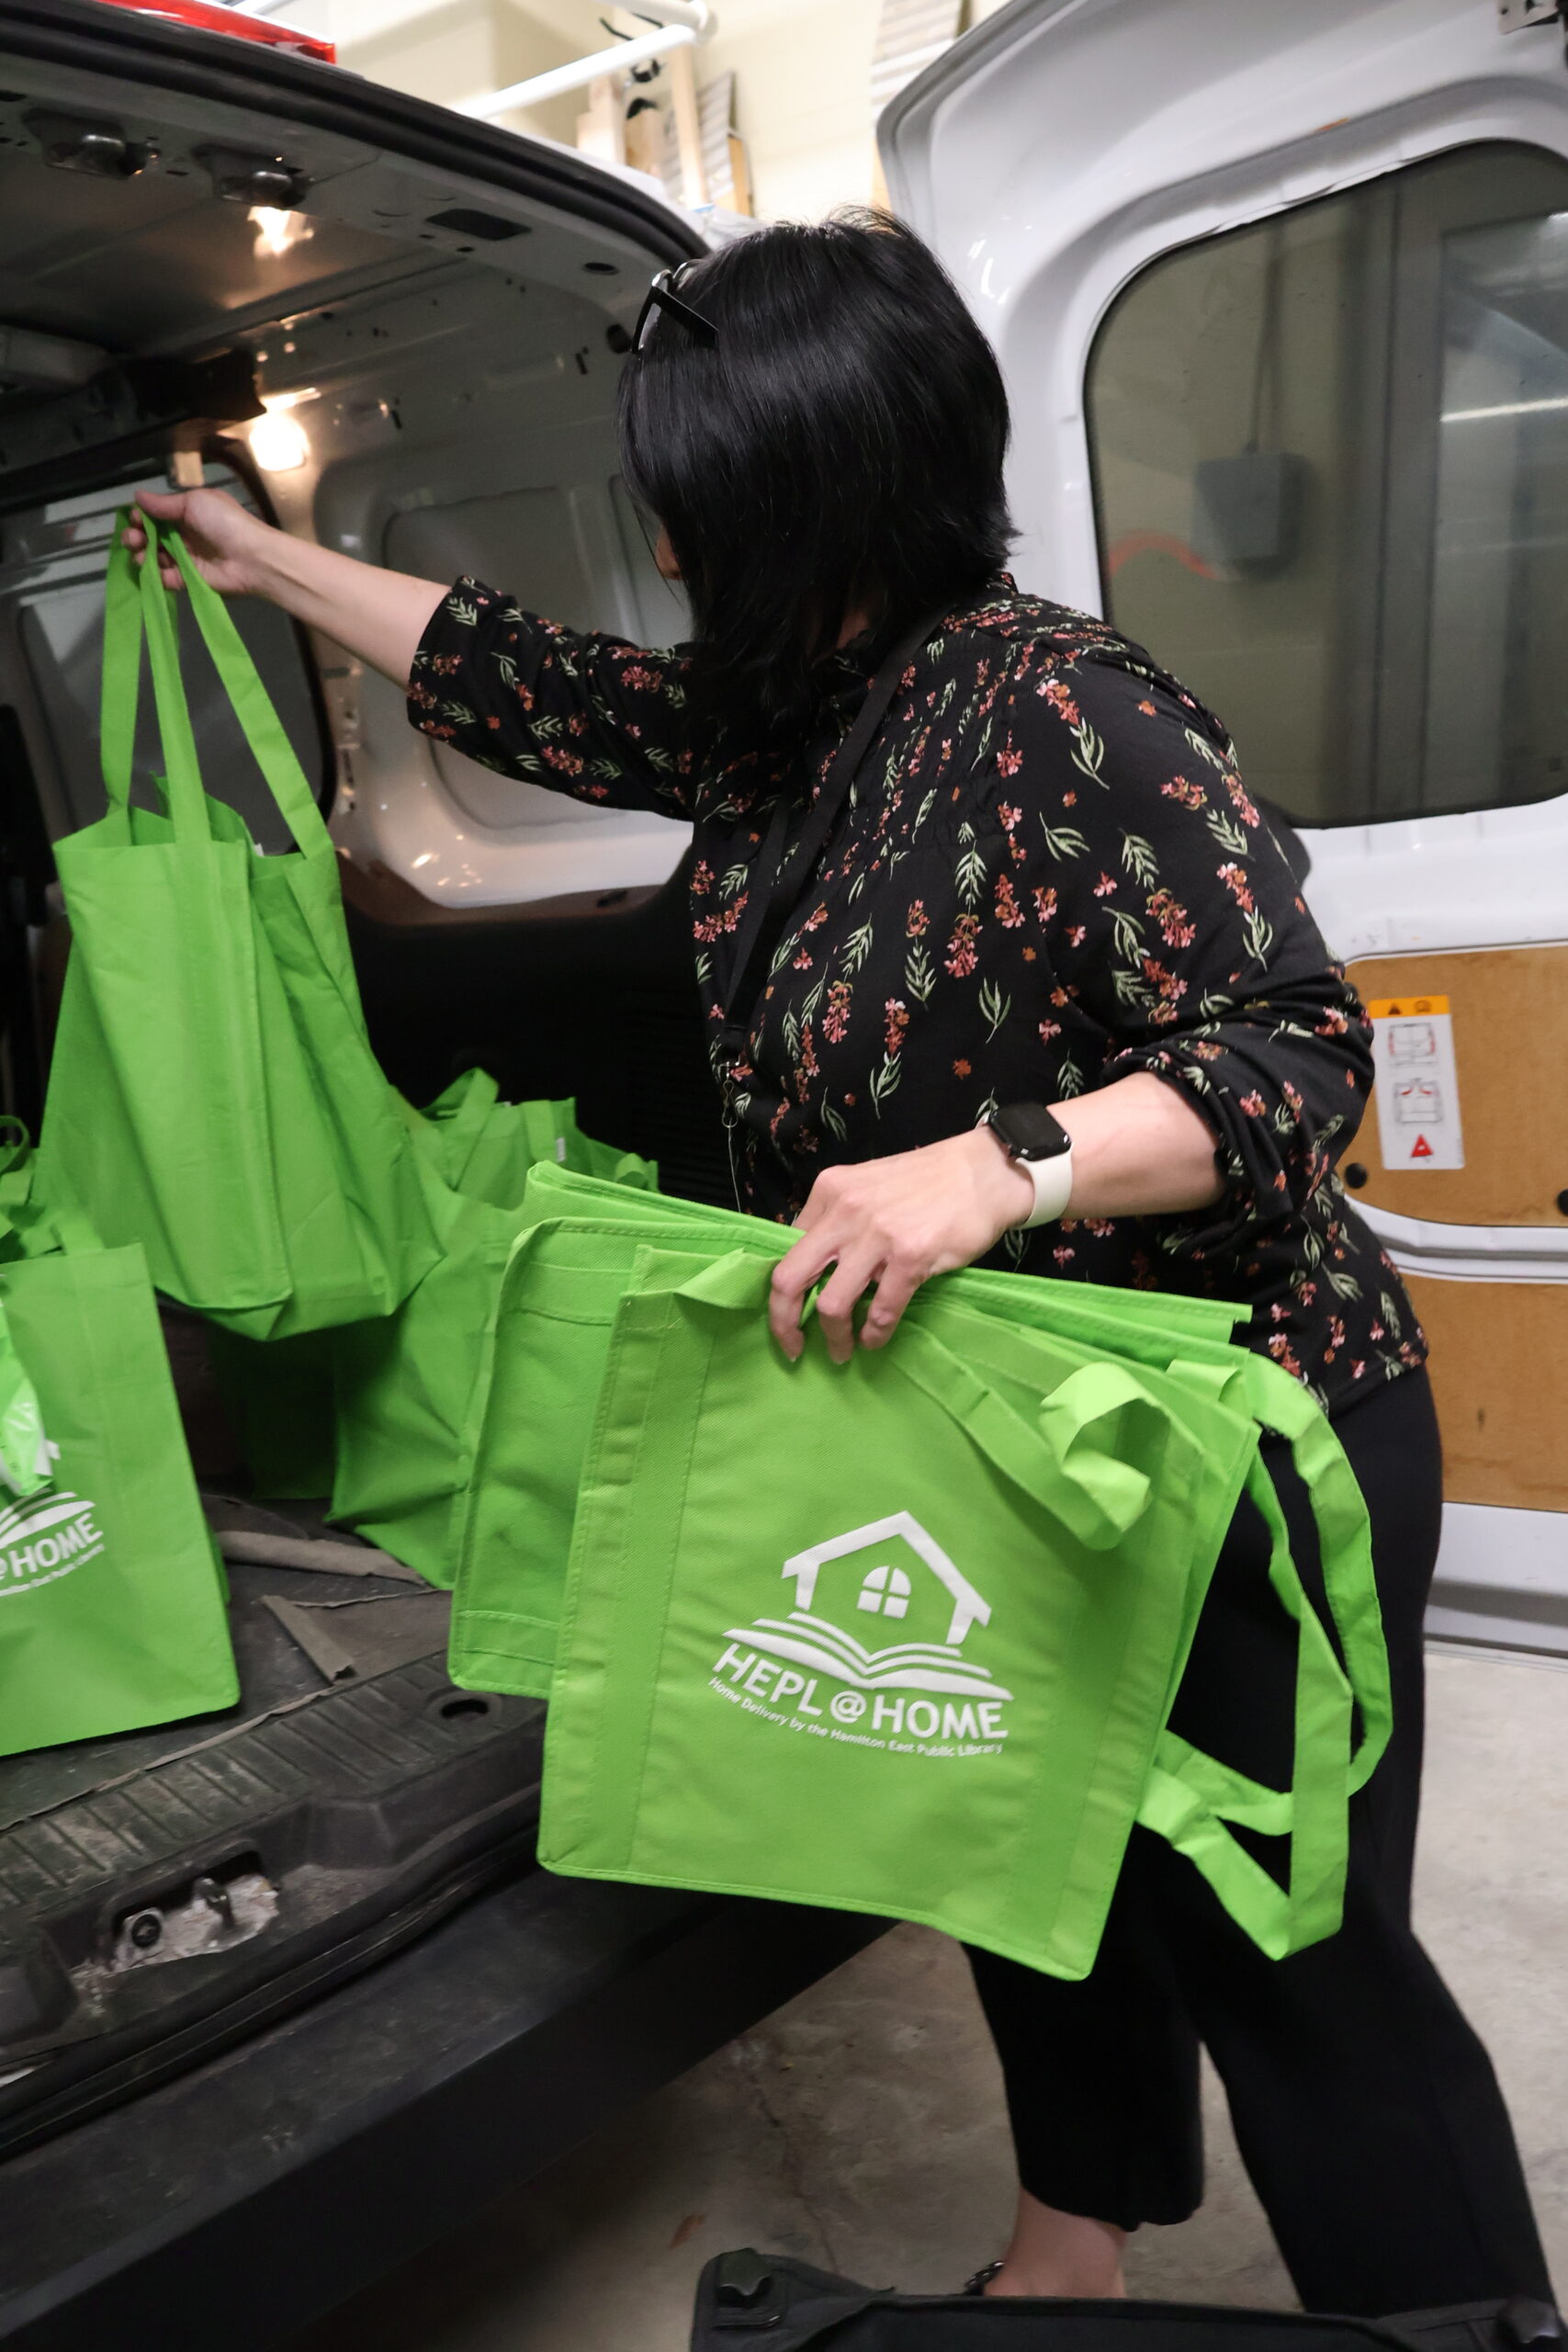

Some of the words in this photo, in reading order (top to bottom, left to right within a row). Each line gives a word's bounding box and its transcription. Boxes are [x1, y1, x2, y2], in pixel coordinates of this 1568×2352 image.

[707, 1677, 742, 1703] Home
[740, 1697, 790, 1726] Delivery
[789, 1717, 807, 1732] by
[807, 1724, 829, 1737] the
[830, 1729, 886, 1748] Hamilton
[888, 1740, 915, 1753] East
[917, 1744, 955, 1757] Public
[957, 1744, 1003, 1757] Library
